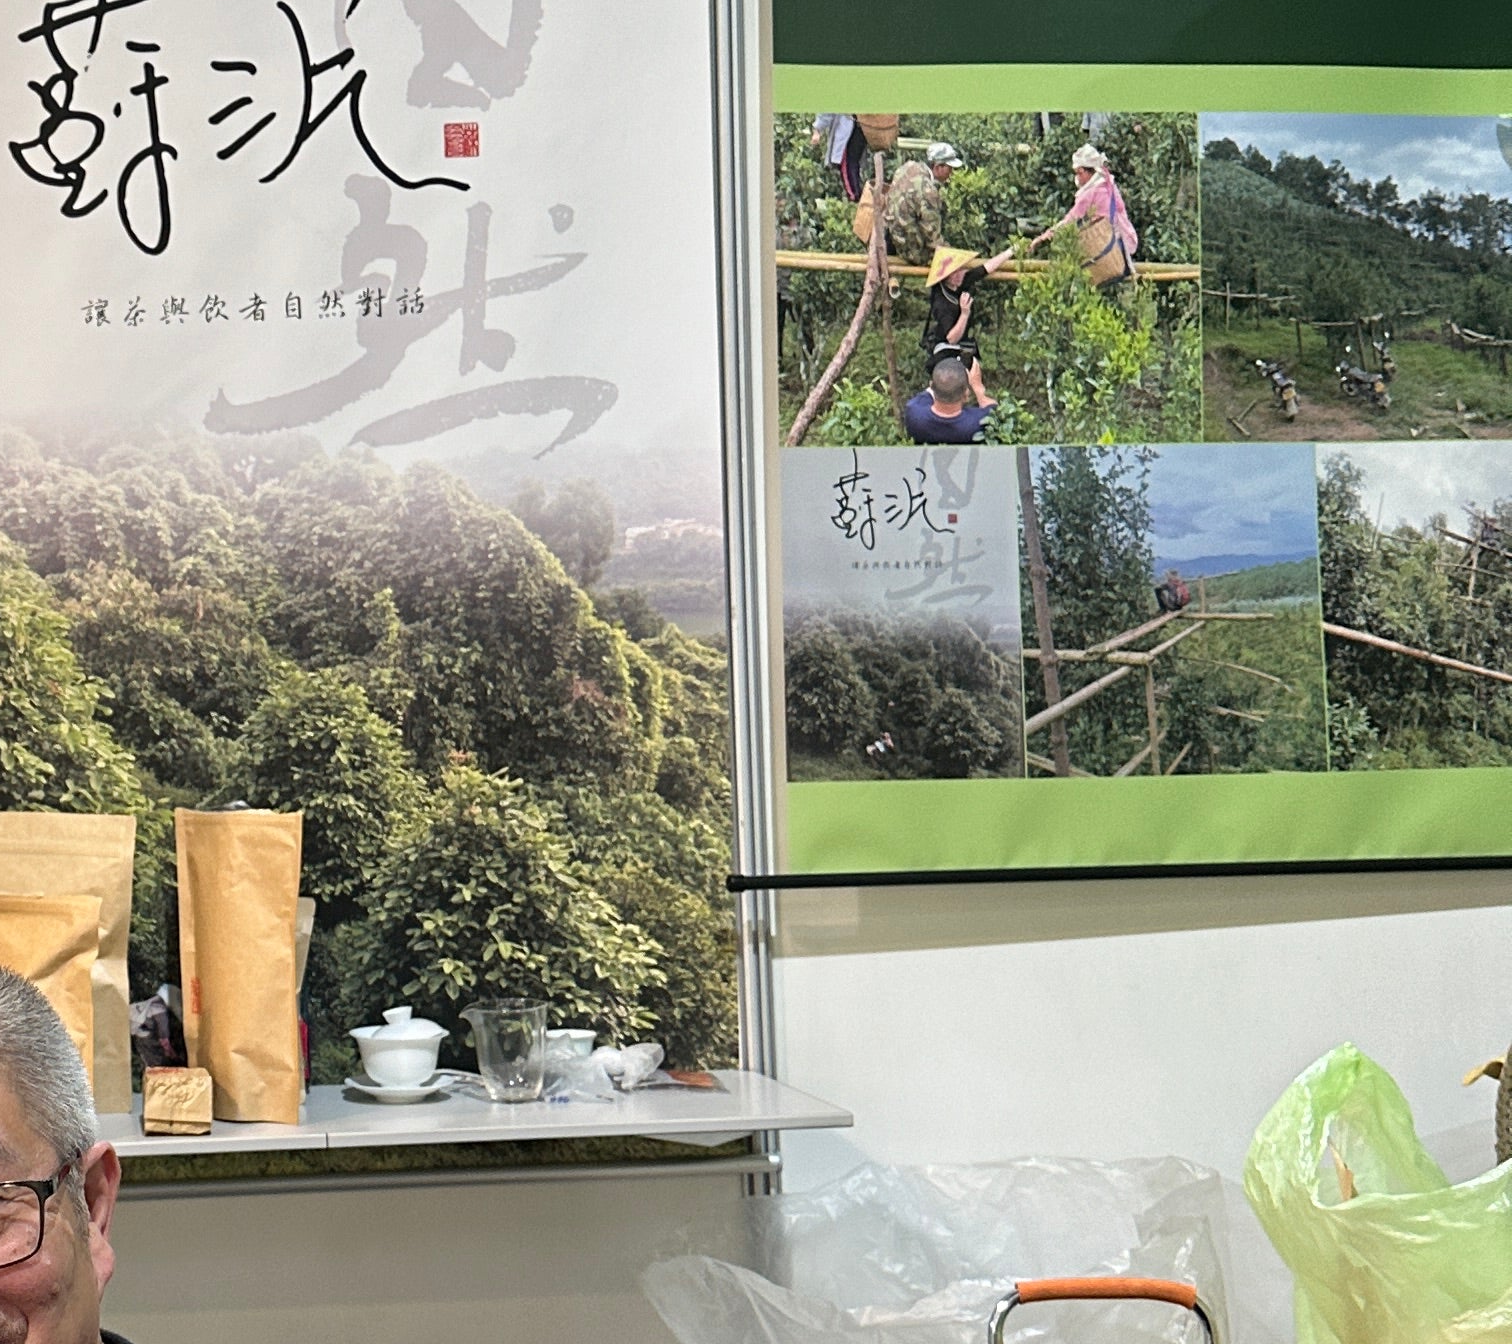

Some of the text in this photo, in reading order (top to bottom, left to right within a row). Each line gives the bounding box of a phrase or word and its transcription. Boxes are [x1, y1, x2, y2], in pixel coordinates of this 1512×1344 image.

[81, 287, 426, 328] 讓茶與飲者自然對話
